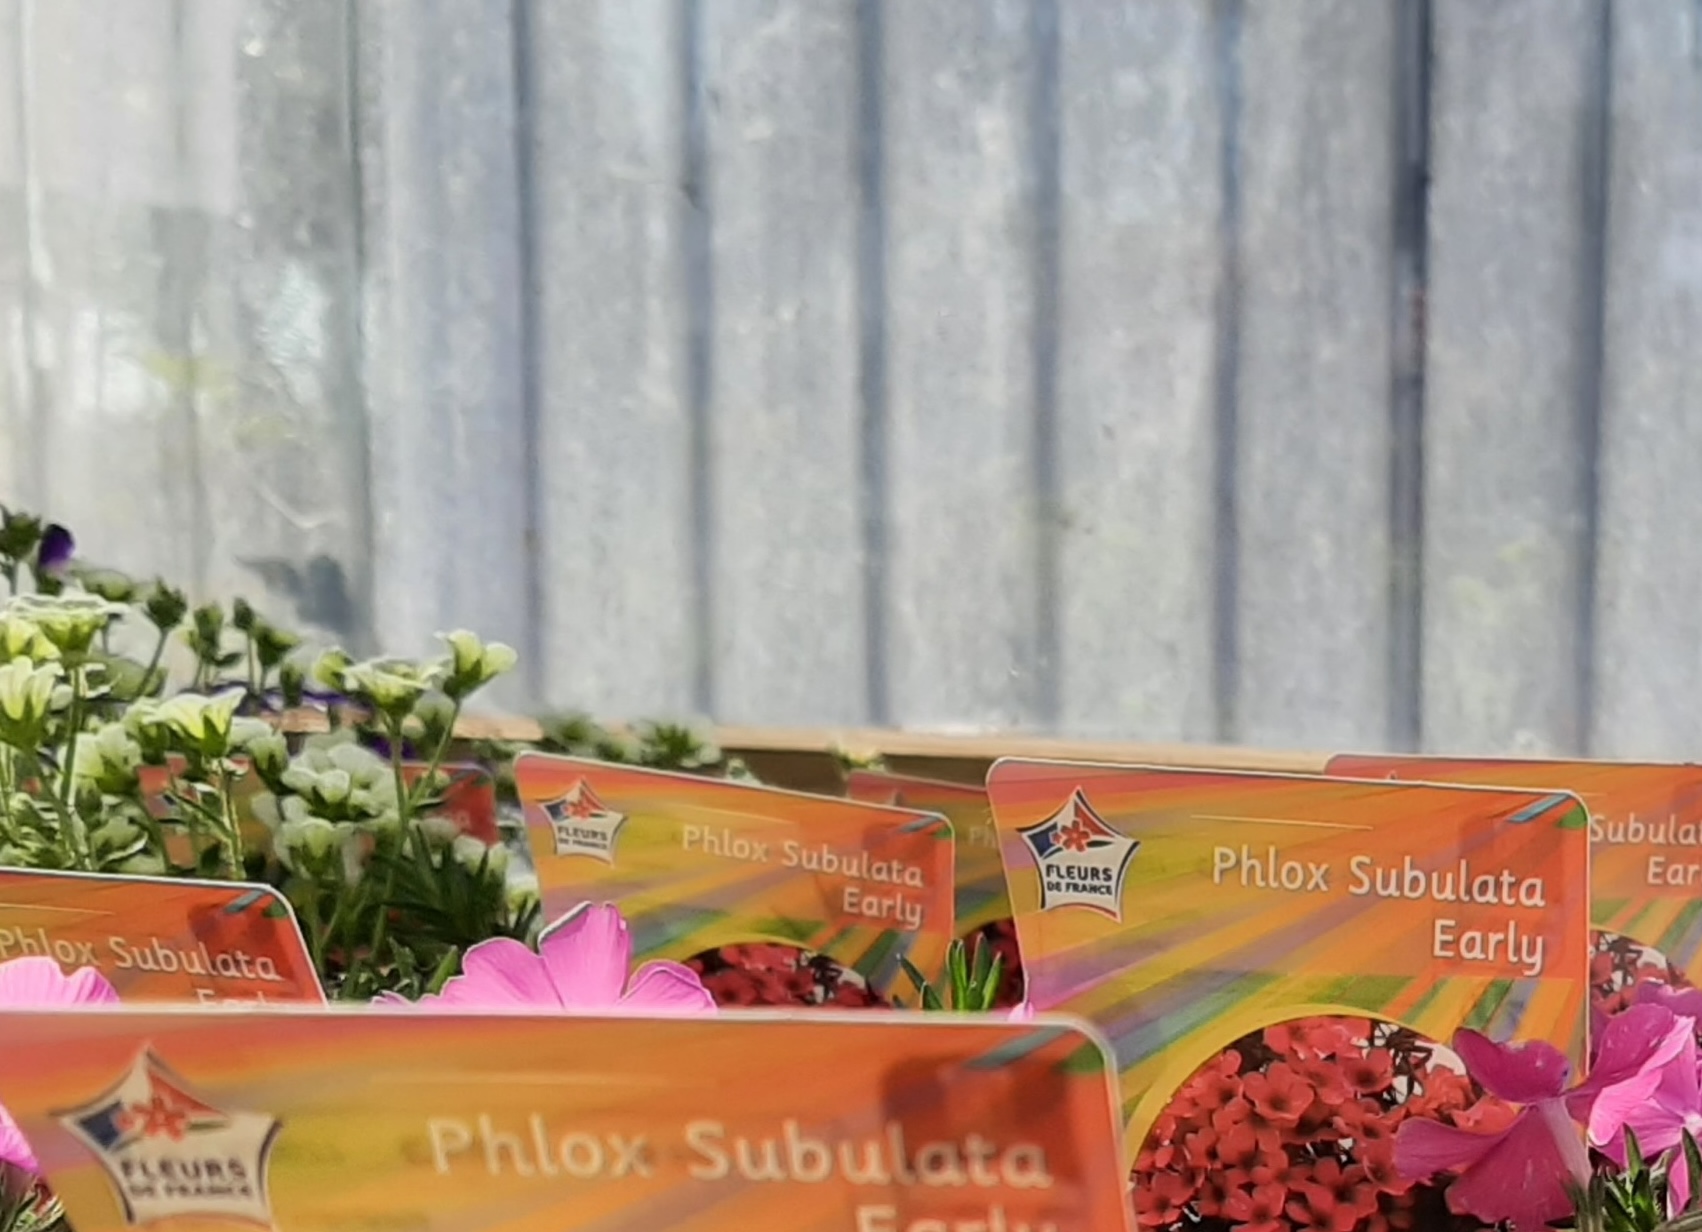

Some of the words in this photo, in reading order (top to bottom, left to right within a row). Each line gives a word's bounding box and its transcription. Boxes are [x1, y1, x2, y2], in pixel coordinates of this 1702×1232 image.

[683, 825, 769, 862] Phlox
[782, 842, 924, 887] Subulata
[1046, 864, 1113, 882] FLEURS
[1213, 846, 1329, 891] Phlox
[1349, 857, 1545, 907] Subulata
[843, 888, 923, 929] Early
[1046, 881, 1062, 892] DE
[1065, 882, 1113, 896] FRANCE
[109, 936, 283, 981] Subulata
[1433, 919, 1544, 975] Early
[121, 1158, 247, 1182] FLEURS
[429, 1113, 650, 1179] Phlox
[685, 1120, 1053, 1189] Subulata
